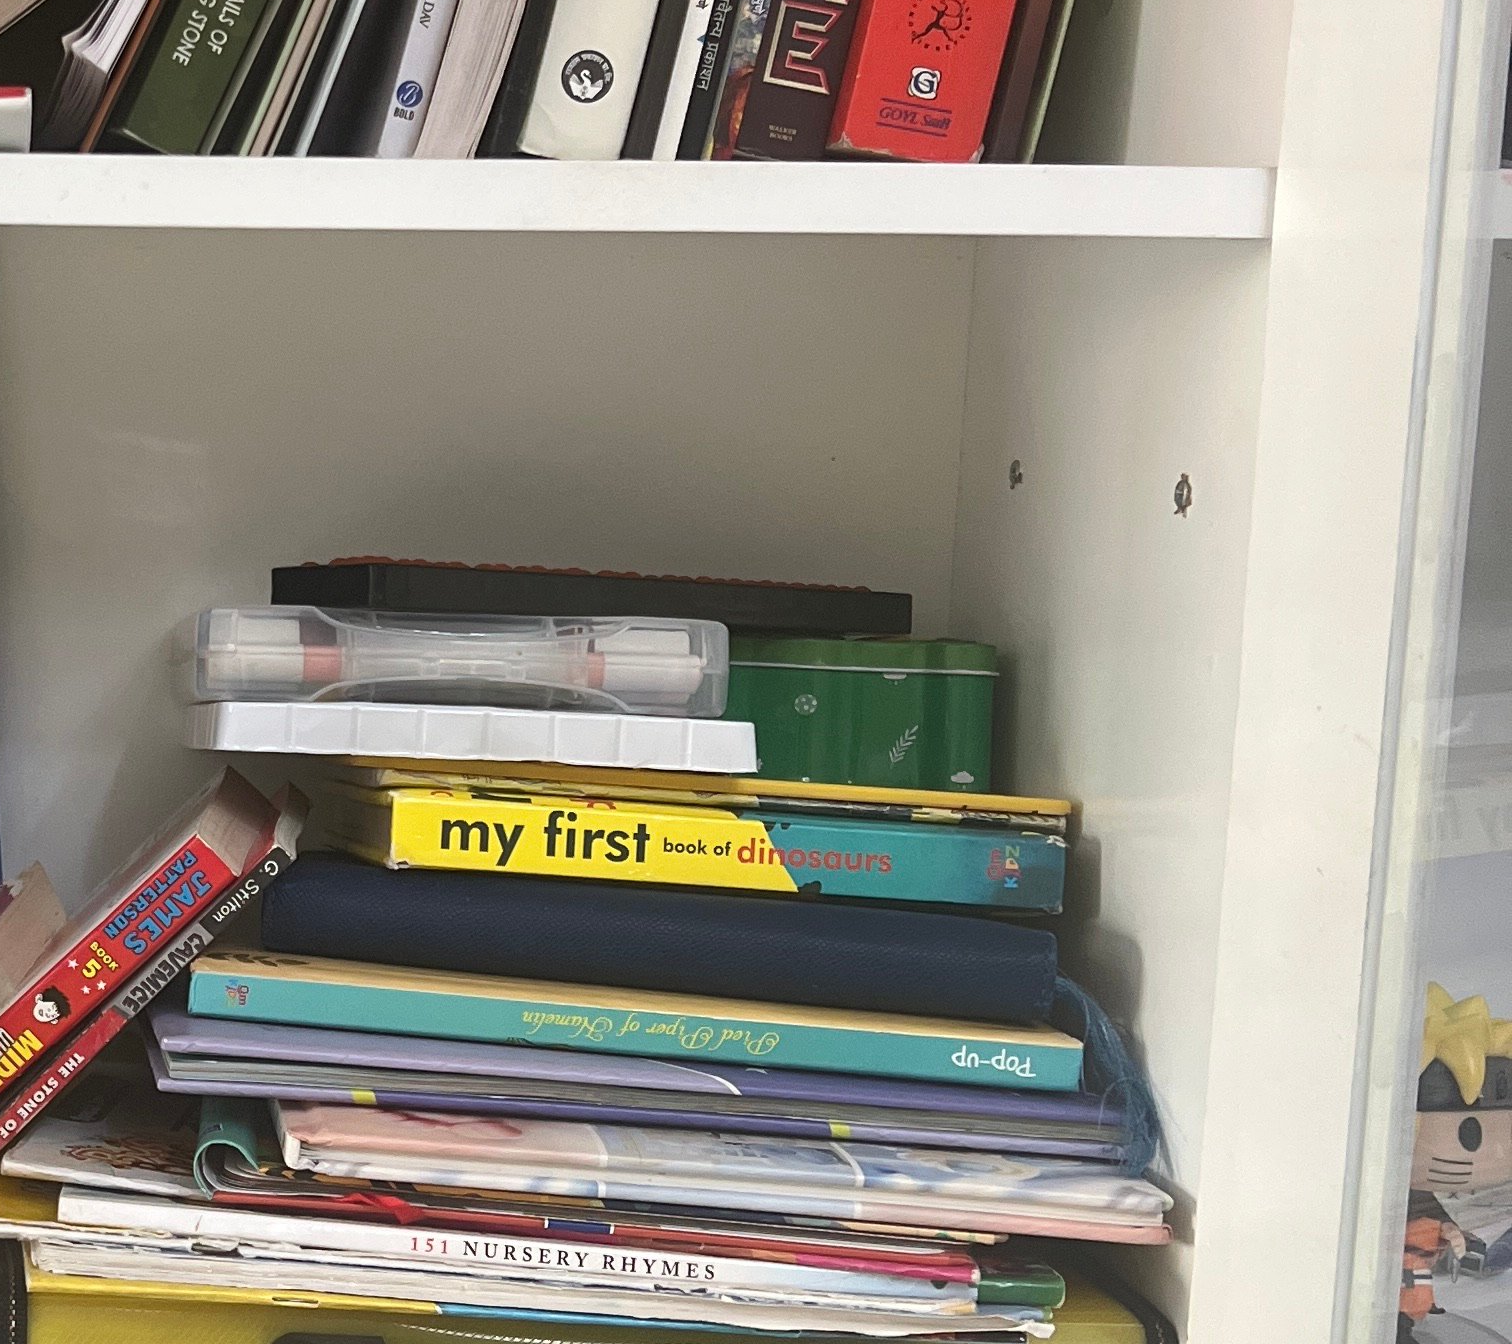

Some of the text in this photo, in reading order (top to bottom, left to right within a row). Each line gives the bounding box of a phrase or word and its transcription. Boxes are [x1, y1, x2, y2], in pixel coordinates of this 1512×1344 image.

[170, 8, 209, 67] STONE
[204, 28, 229, 55] OF
[393, 106, 414, 121] BOLD
[440, 811, 893, 875] my first book of dinosaurs
[102, 846, 198, 942] PATTERSON
[120, 866, 215, 959] JAMES
[208, 877, 263, 925] Stilton
[116, 929, 210, 1016] CAVEMICE
[519, 1007, 780, 1058] Pied Piper of Hamelin
[56, 1050, 86, 1079] THE
[949, 1040, 1038, 1080] Pop-up
[15, 1075, 61, 1120] STONE
[410, 1234, 716, 1281] 151 NURSERY RHYMES
